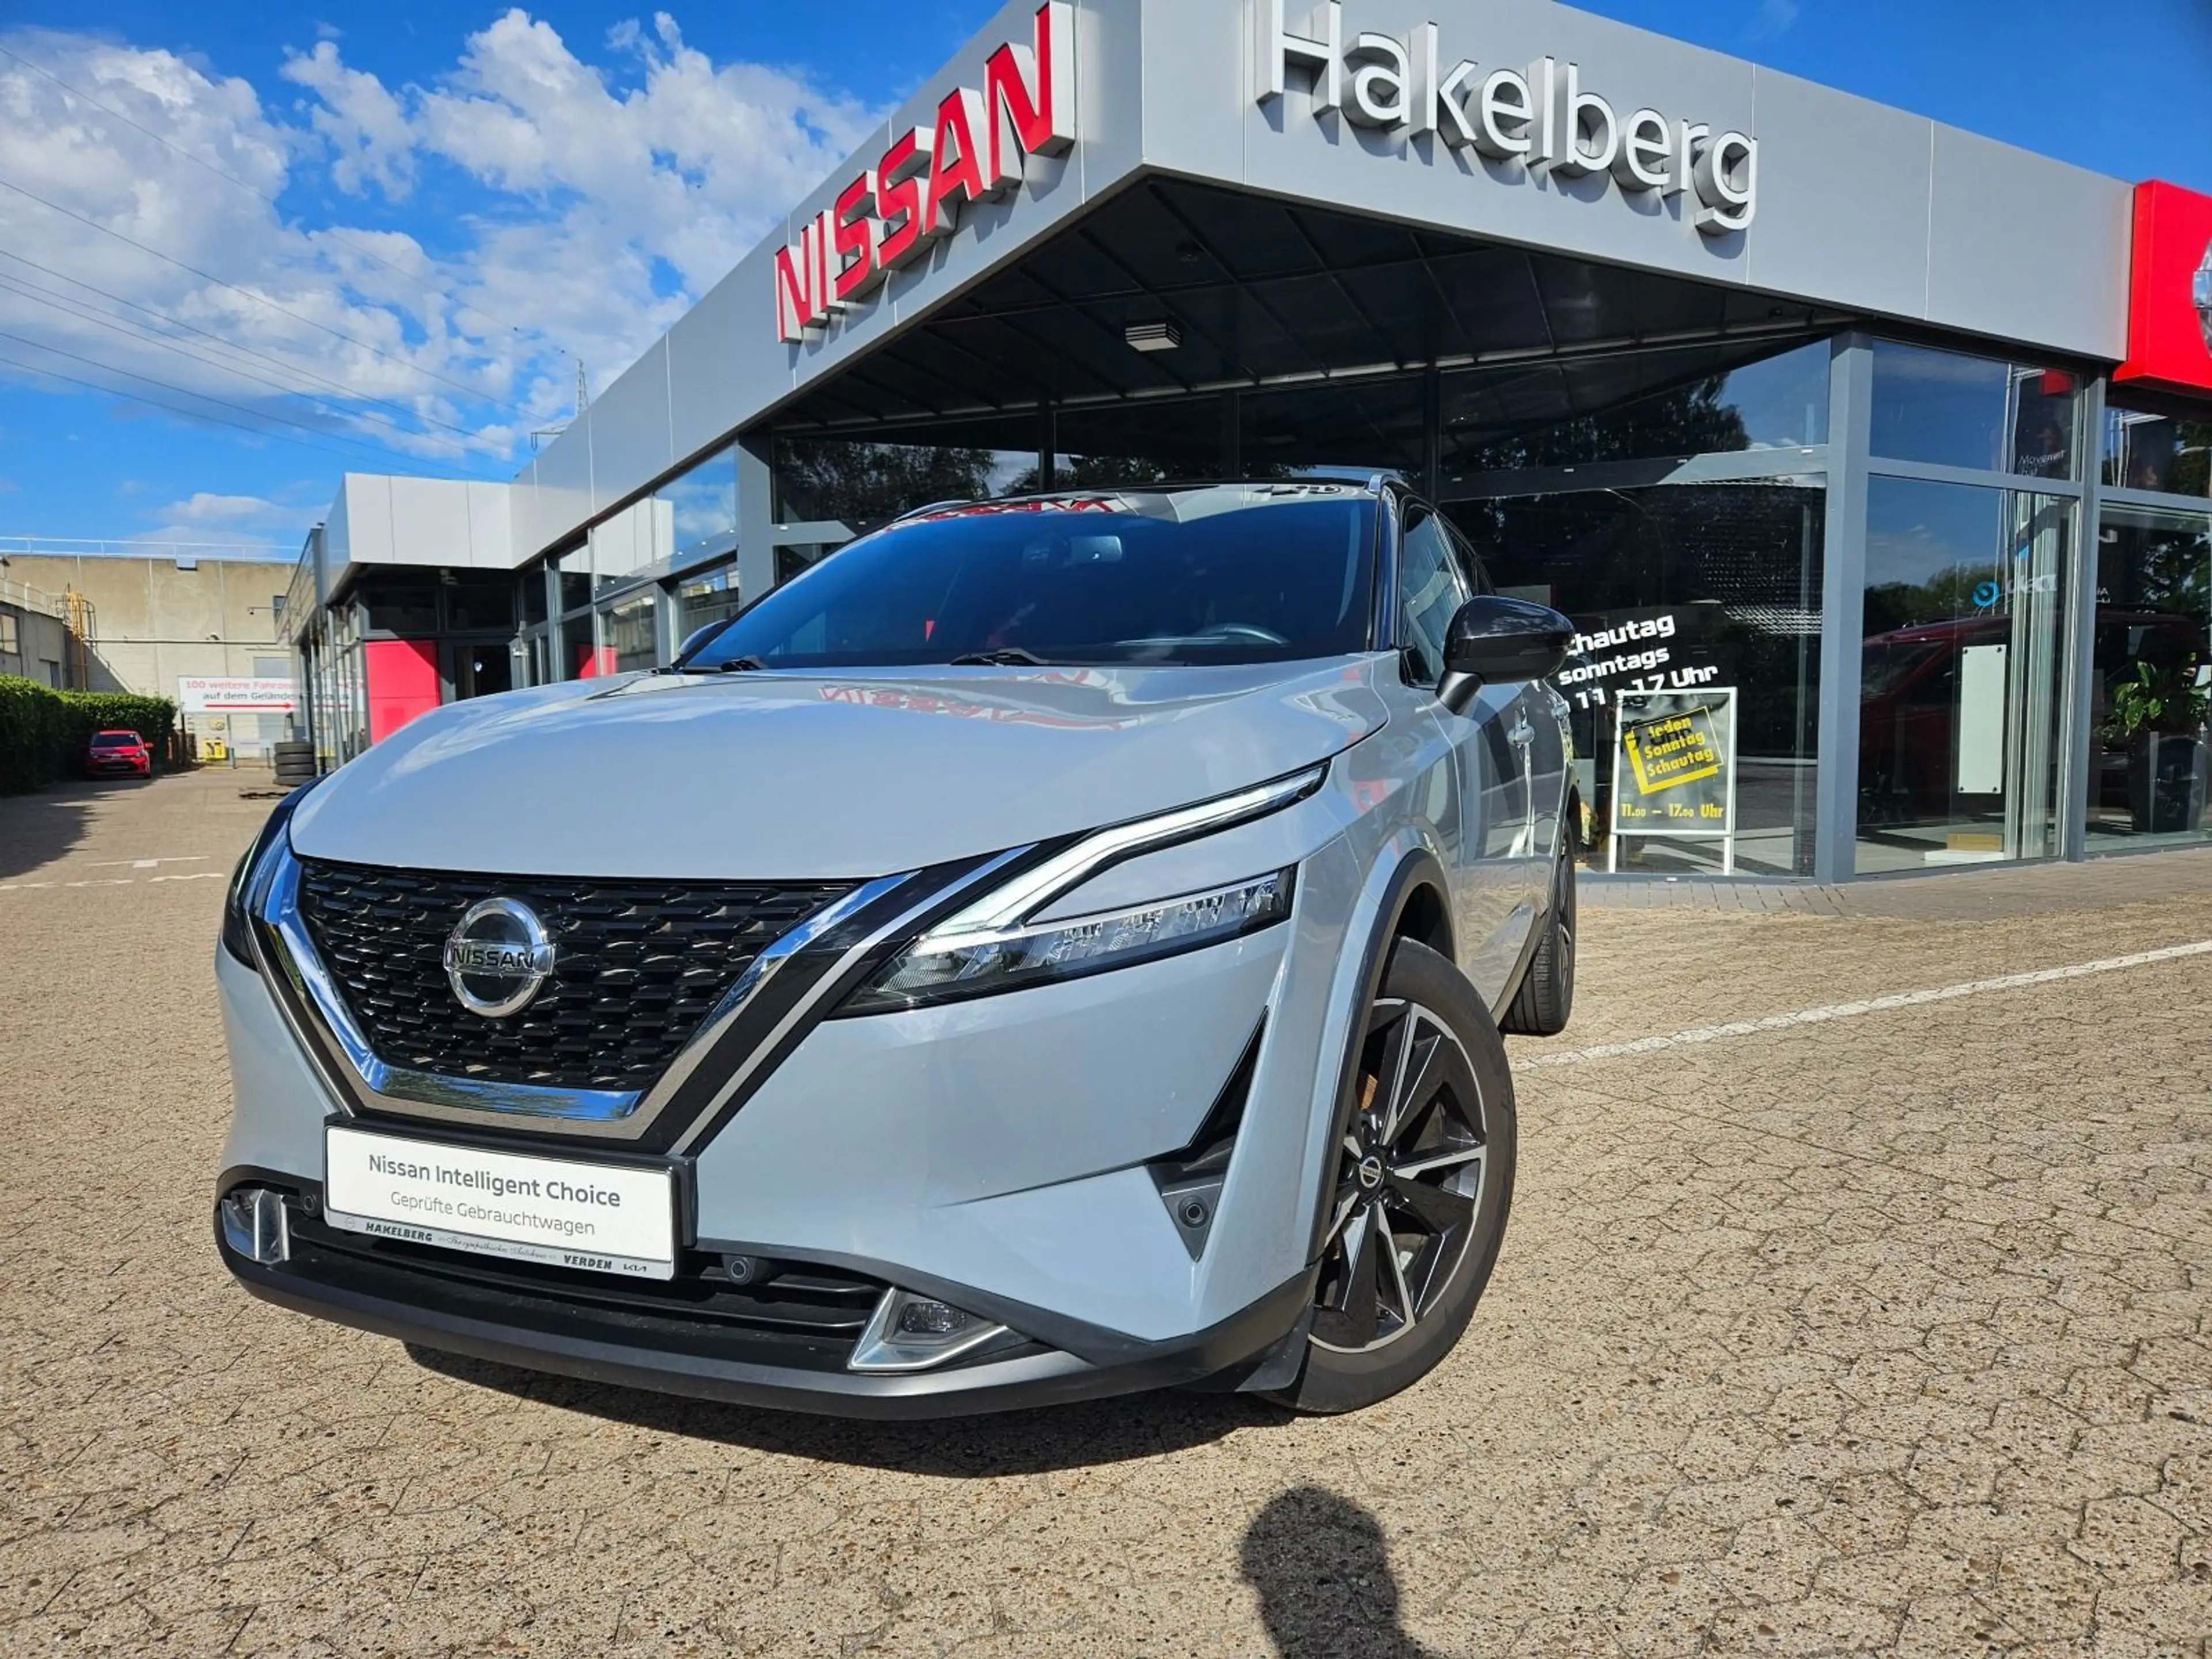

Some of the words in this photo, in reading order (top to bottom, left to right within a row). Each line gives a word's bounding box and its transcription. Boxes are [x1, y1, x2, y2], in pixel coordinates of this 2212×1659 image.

[1257, 0, 1758, 233] Hakelberg
[775, 1, 1074, 343] NISSAN
[1567, 615, 1676, 657] chautag
[1559, 647, 1669, 685] sonntags
[1631, 673, 1664, 696] 17
[1671, 665, 1718, 688] Uhr
[186, 680, 206, 689] 100
[209, 680, 250, 690] weitere
[203, 691, 220, 700] auf
[224, 692, 248, 700] dem
[1647, 717, 1692, 738] Jeden
[1644, 730, 1705, 760] Sonntag
[1646, 748, 1714, 778] Schautag
[1700, 803, 1724, 818] Uhr
[453, 948, 534, 970] NISSAN
[369, 1154, 430, 1181] Nissan
[436, 1165, 540, 1197] Intelligent
[546, 1182, 621, 1207] Choice
[391, 1191, 453, 1215] Geprüfte
[457, 1203, 595, 1236] Gebrauchtwagen
[365, 1222, 433, 1241] HAKELBERG
[564, 1255, 612, 1270] VERDEN
